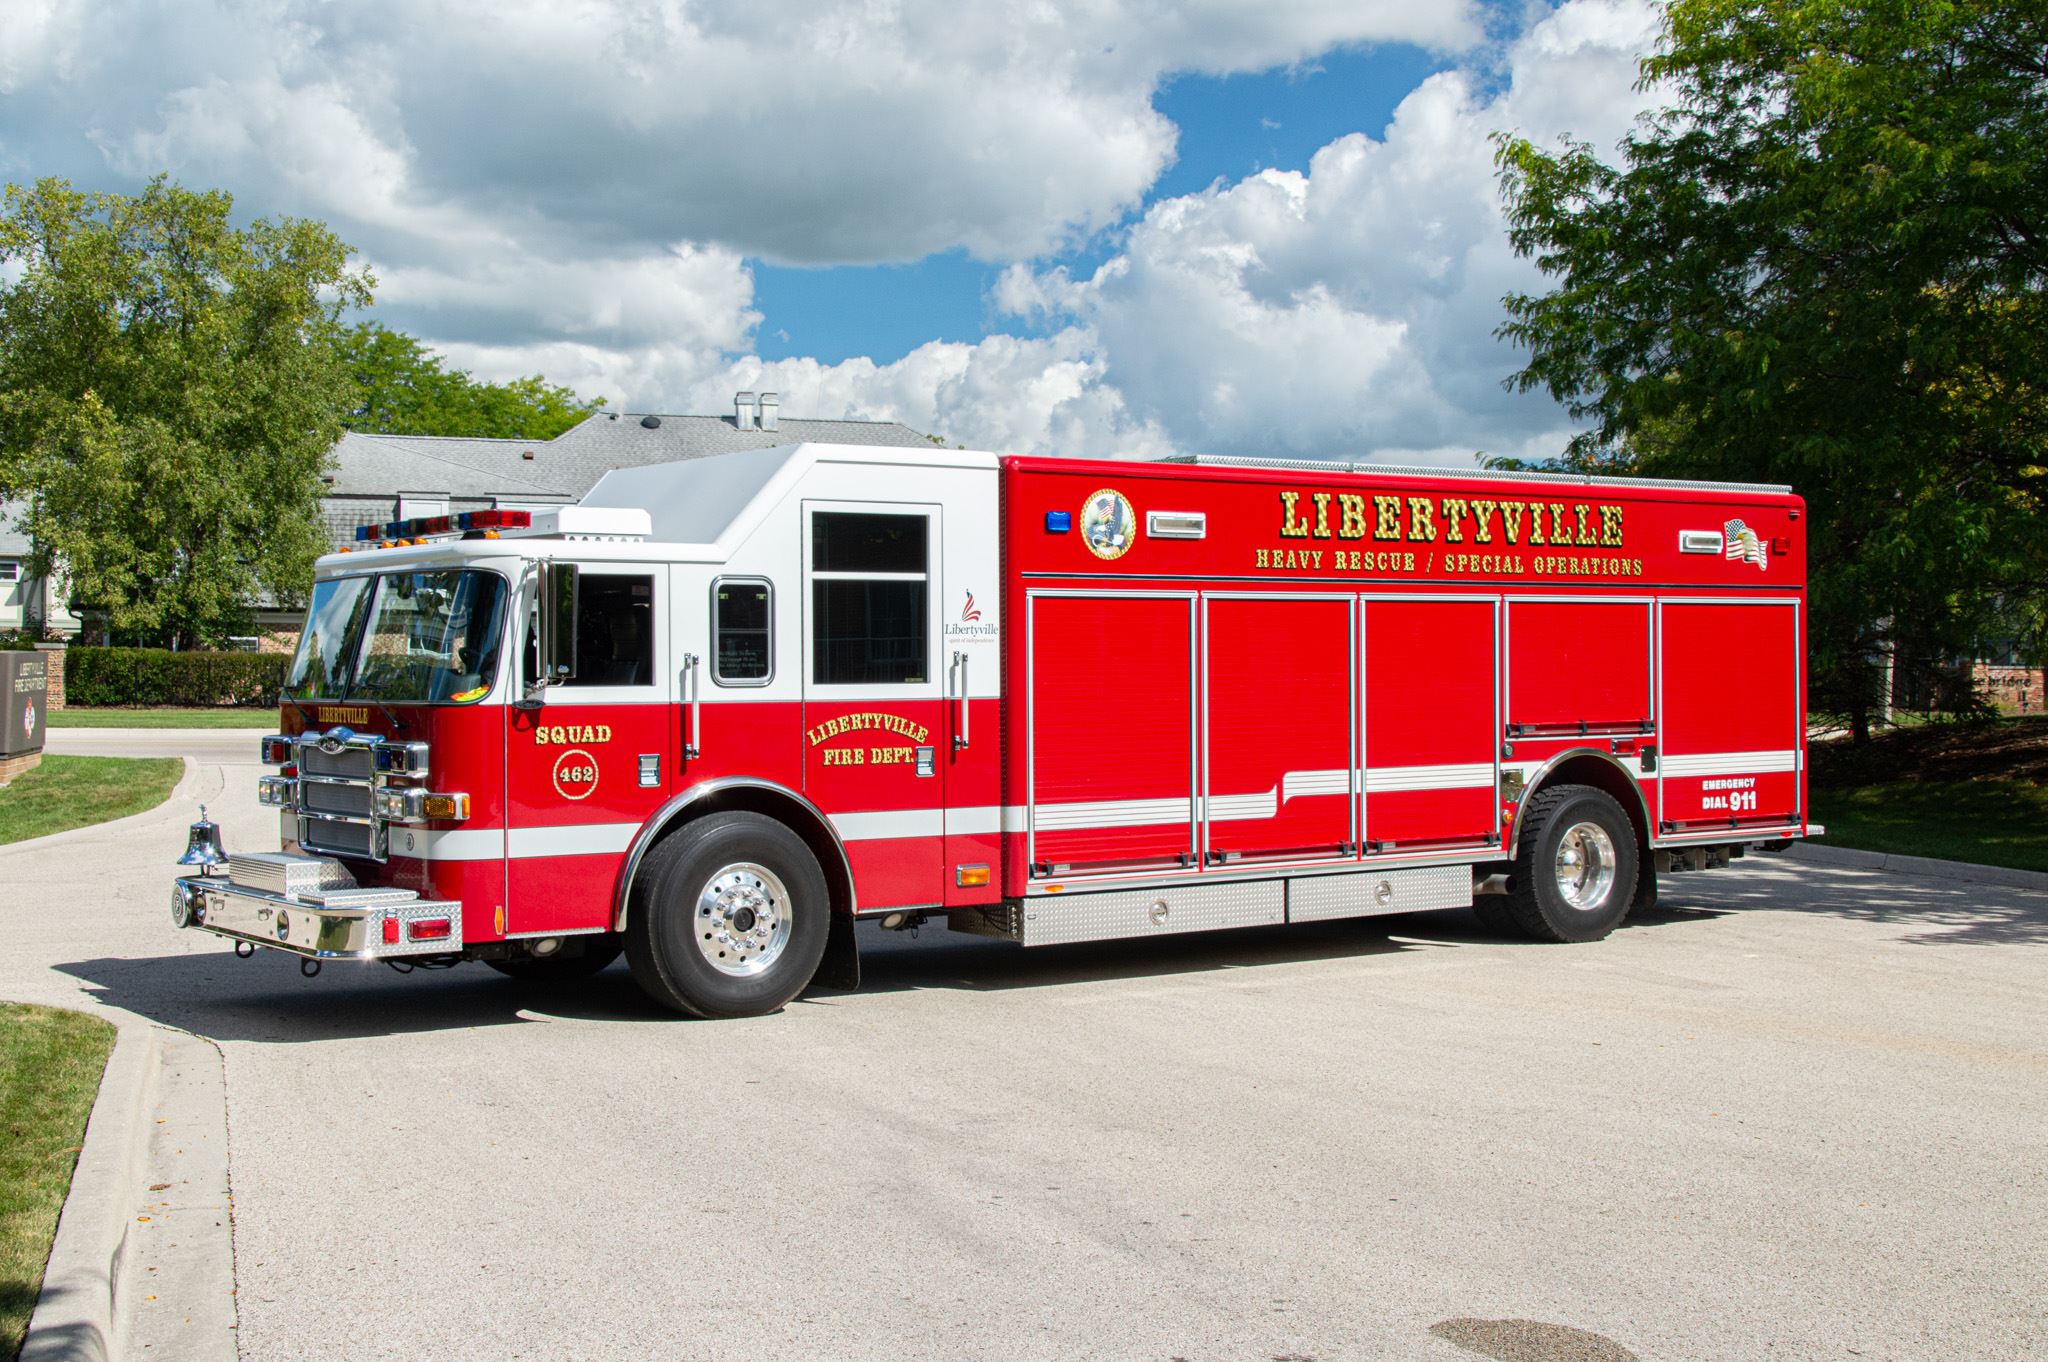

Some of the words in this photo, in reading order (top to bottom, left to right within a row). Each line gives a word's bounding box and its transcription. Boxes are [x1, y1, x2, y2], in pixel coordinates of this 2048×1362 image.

[1280, 491, 1624, 546] LIBERTYVILLE
[1255, 548, 1323, 569] HEAVY
[1334, 550, 1415, 571] RESCUE
[1426, 552, 1434, 573] /
[1445, 553, 1524, 574] SPECIAL
[1533, 555, 1642, 576] OPERATIONS
[945, 623, 998, 637] Libertyville
[318, 706, 369, 724] LIBERTYVILLE
[535, 725, 612, 745] SQUAD
[806, 712, 929, 746] LIBERTYVILLE
[823, 748, 865, 766] FIRE
[870, 746, 914, 764] DEPT.
[558, 765, 594, 783] 462
[1702, 777, 1756, 791] EMERGENCY
[1702, 796, 1729, 810] DIAL
[1729, 791, 1757, 811] 911
